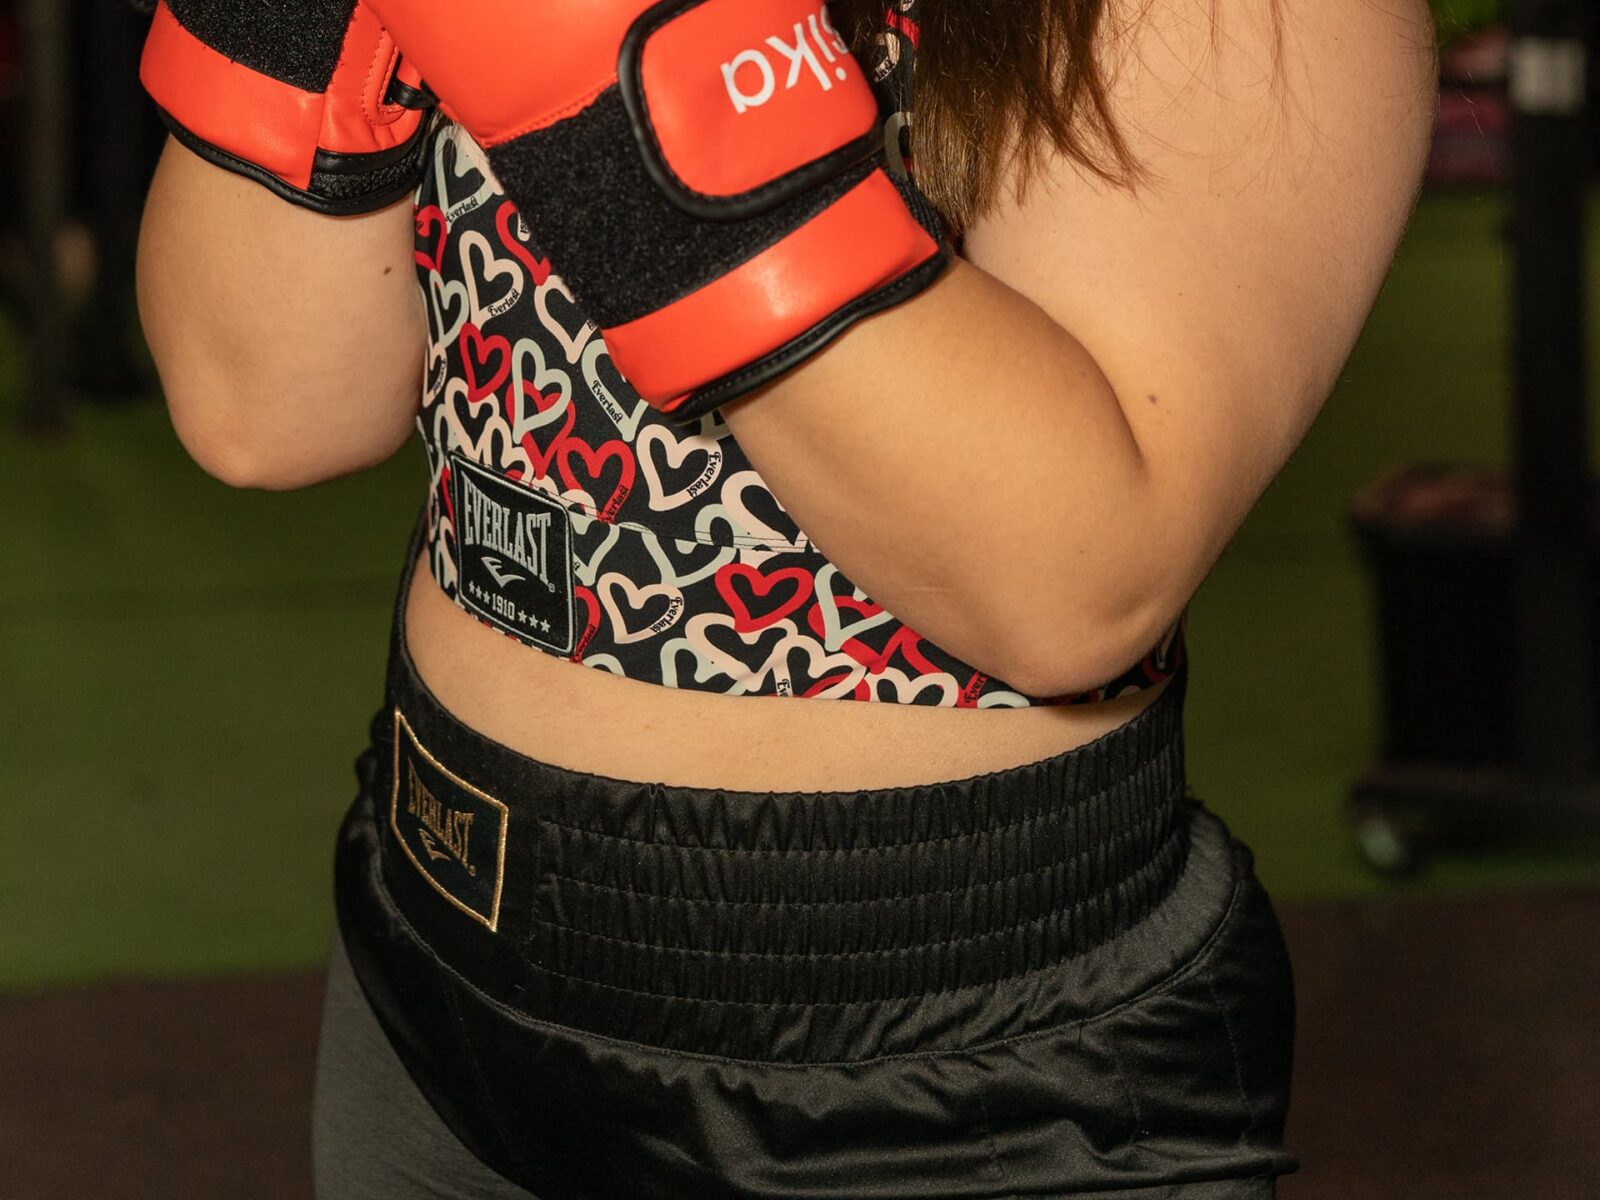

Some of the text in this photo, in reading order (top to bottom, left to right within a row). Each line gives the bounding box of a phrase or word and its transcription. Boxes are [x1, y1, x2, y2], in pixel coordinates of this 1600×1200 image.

[445, 195, 479, 224] Everlast
[486, 287, 521, 318] Everlast
[592, 379, 624, 424] Everlast
[685, 451, 722, 499] Everlast
[460, 469, 552, 585] EVERLAST
[491, 592, 516, 622] 1910
[649, 596, 684, 634] Everlast
[407, 755, 475, 870] EVERLAST
